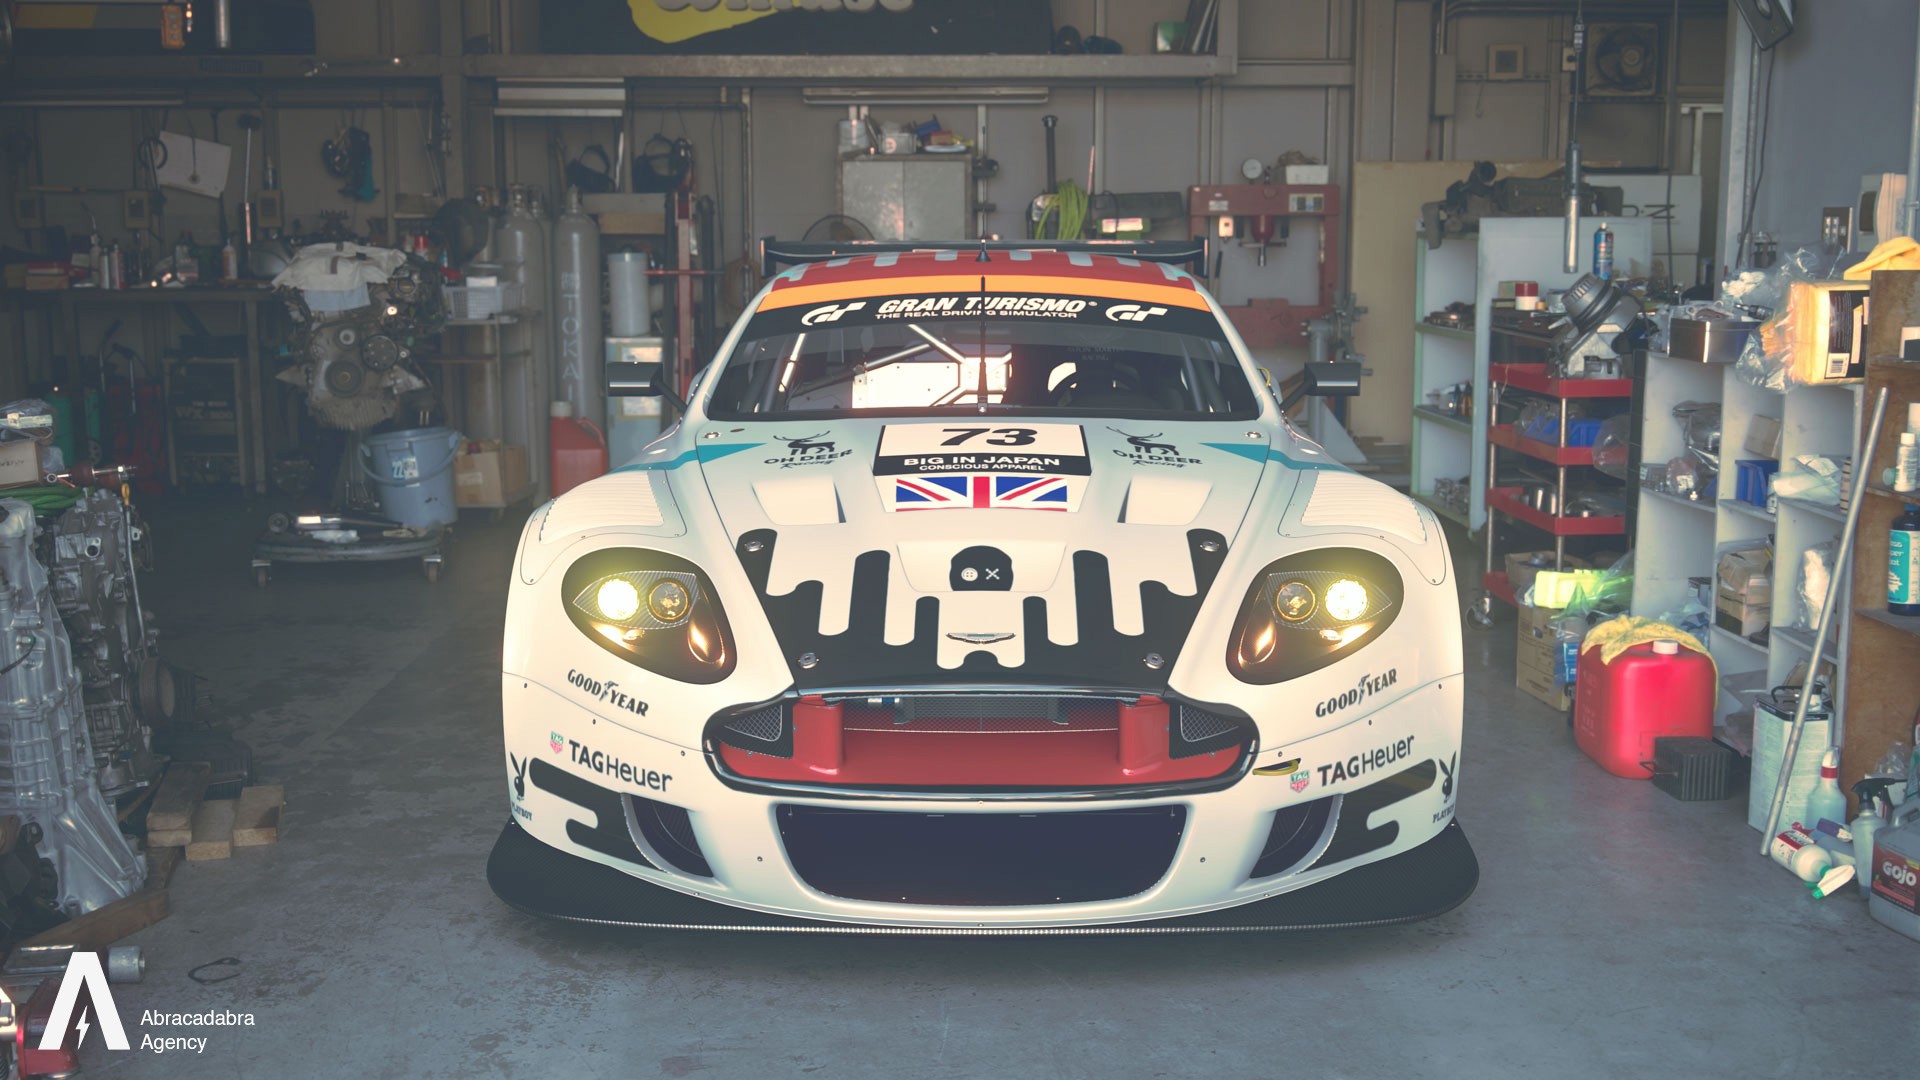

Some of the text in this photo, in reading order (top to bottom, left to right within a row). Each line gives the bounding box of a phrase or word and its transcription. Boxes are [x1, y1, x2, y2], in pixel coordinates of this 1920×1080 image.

[878, 297, 959, 313] GRAN
[875, 312, 901, 320] THE
[904, 310, 938, 318] REAL
[999, 310, 1077, 319] SIMULATOR
[561, 293, 581, 401] TOKAI
[940, 428, 1038, 447] 73
[764, 448, 854, 465] OH DEER
[903, 456, 1060, 467] BIG IN JAPAN
[1112, 449, 1204, 465] OH DEER
[780, 459, 835, 470] Racing
[919, 463, 1046, 471] CONSCIOUS APPAREL
[1132, 459, 1187, 469] Racing
